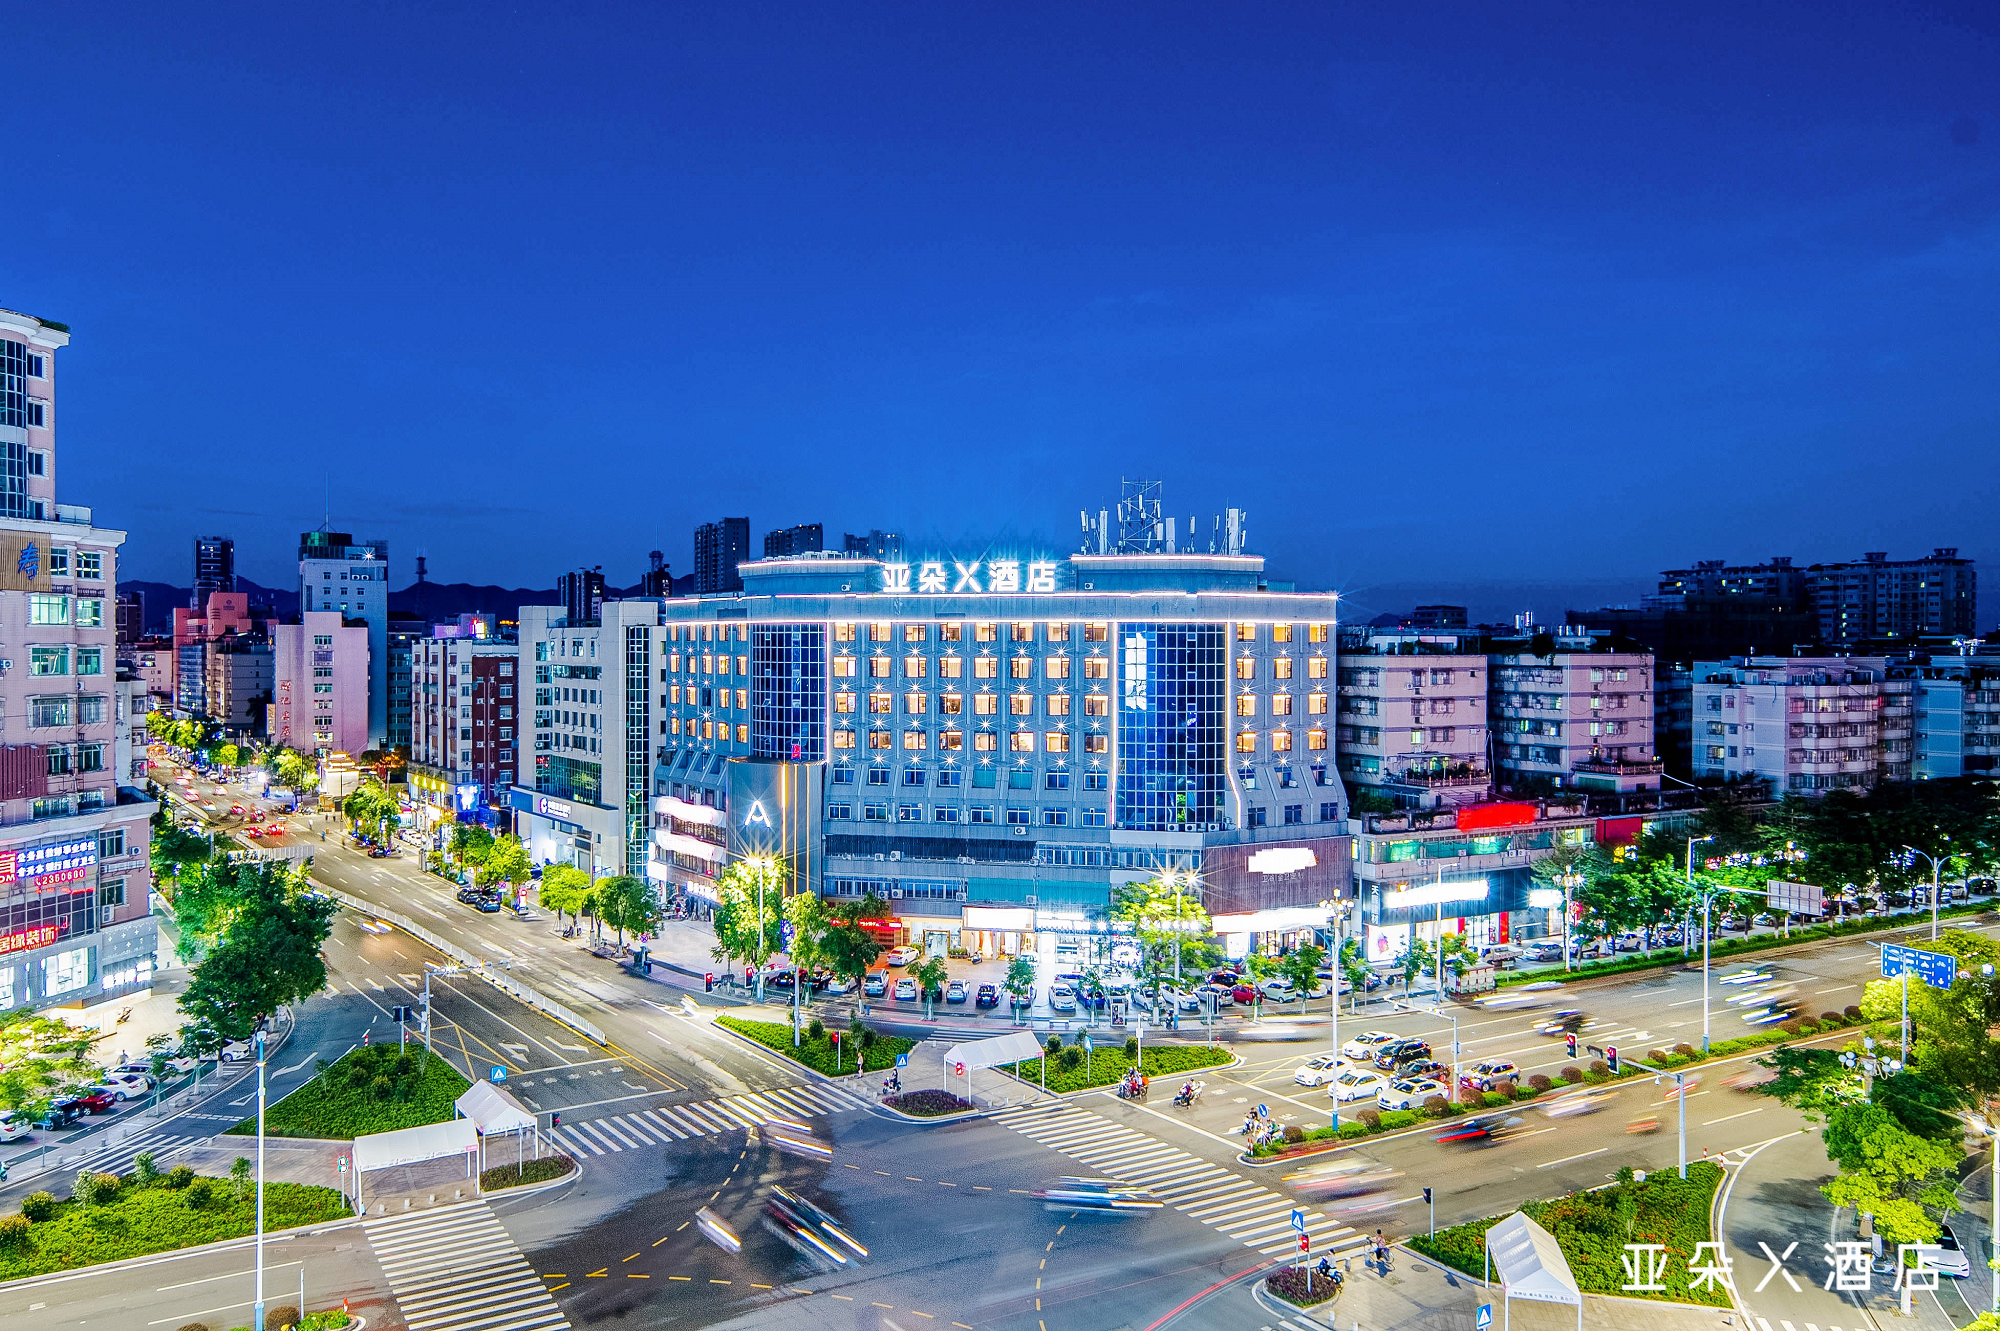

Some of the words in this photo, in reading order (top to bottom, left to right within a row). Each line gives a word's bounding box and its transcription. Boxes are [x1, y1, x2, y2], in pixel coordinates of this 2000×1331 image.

[882, 561, 1056, 593] 亚朵X酒店
[744, 800, 771, 828] A
